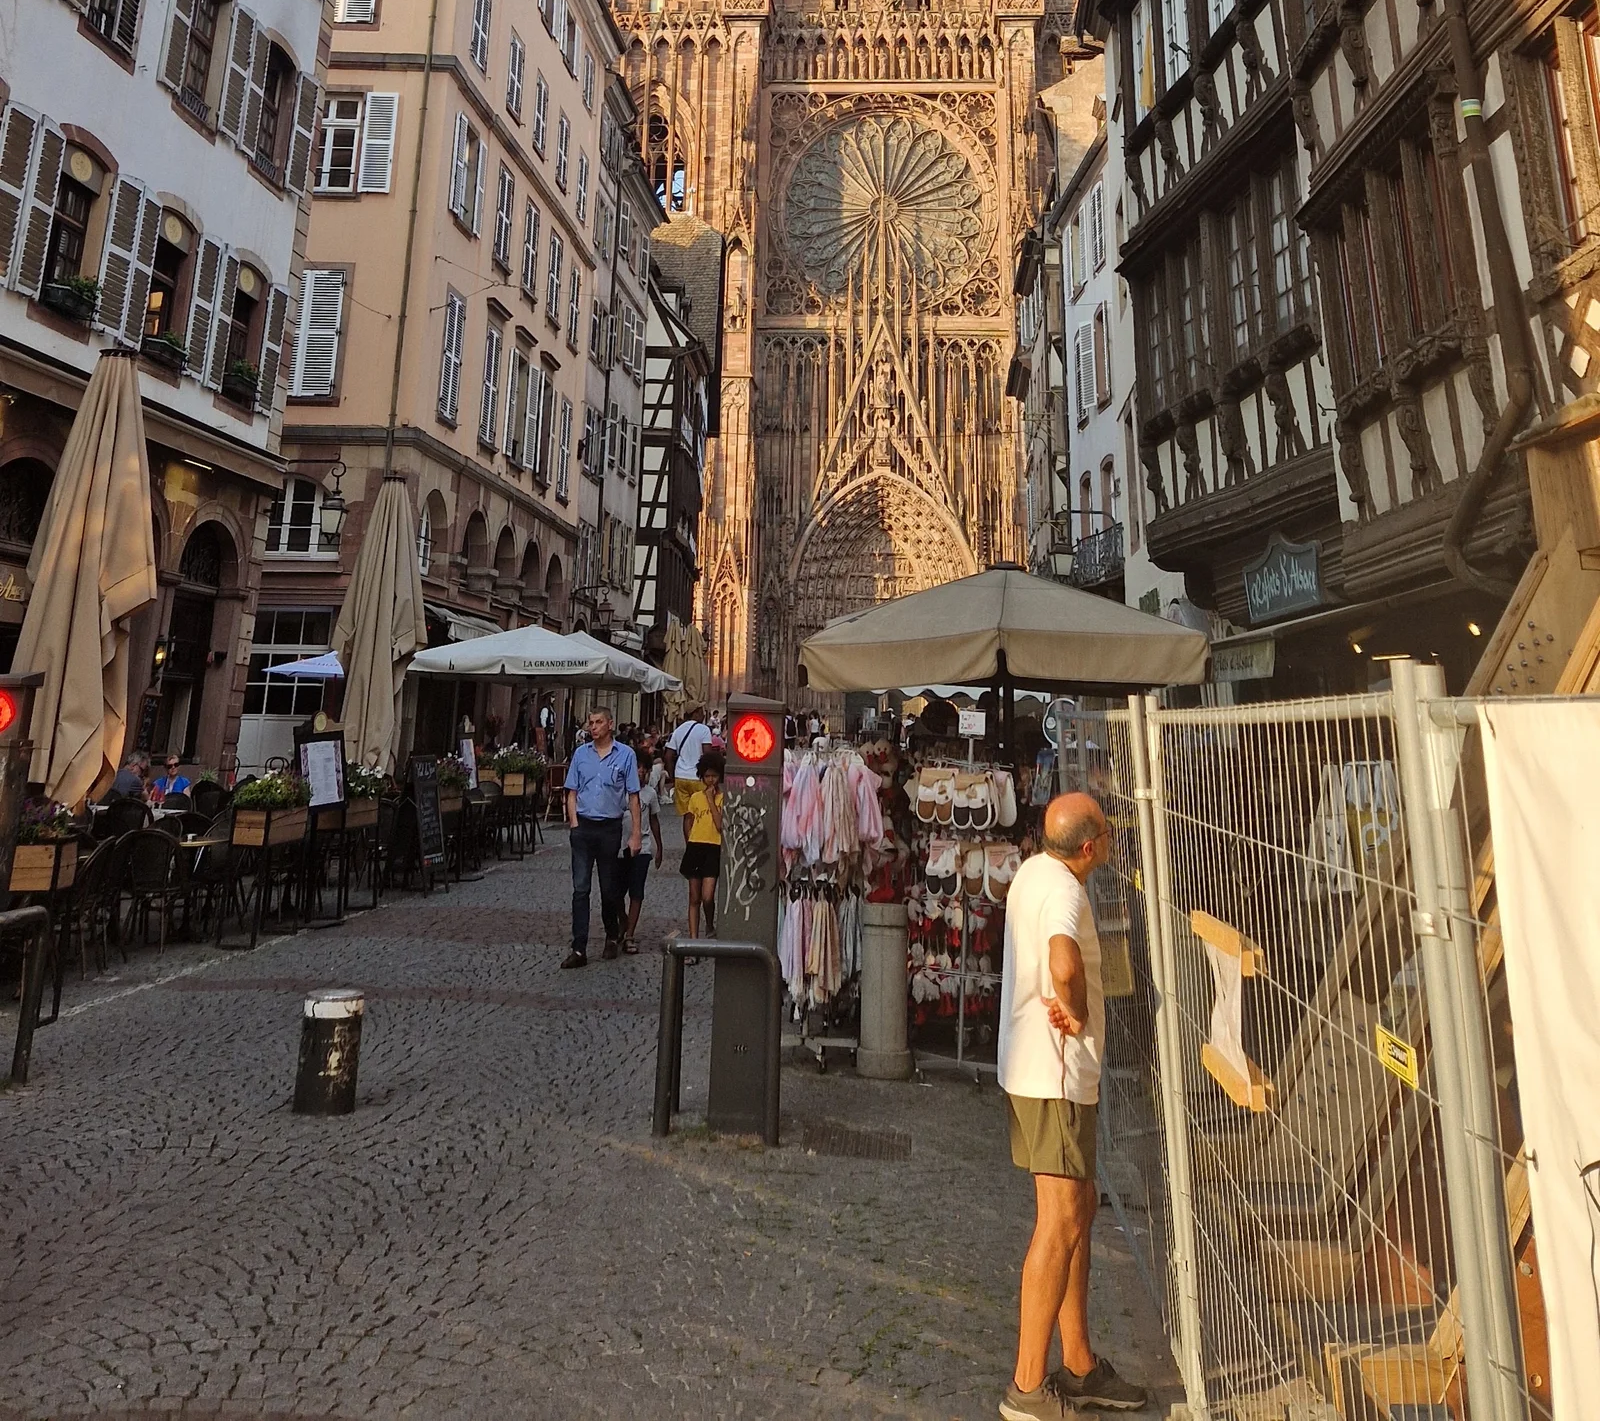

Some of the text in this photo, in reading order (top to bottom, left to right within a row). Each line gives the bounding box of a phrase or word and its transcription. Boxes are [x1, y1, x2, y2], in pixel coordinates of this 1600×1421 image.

[523, 660, 589, 668] LA GRANDE DAME
